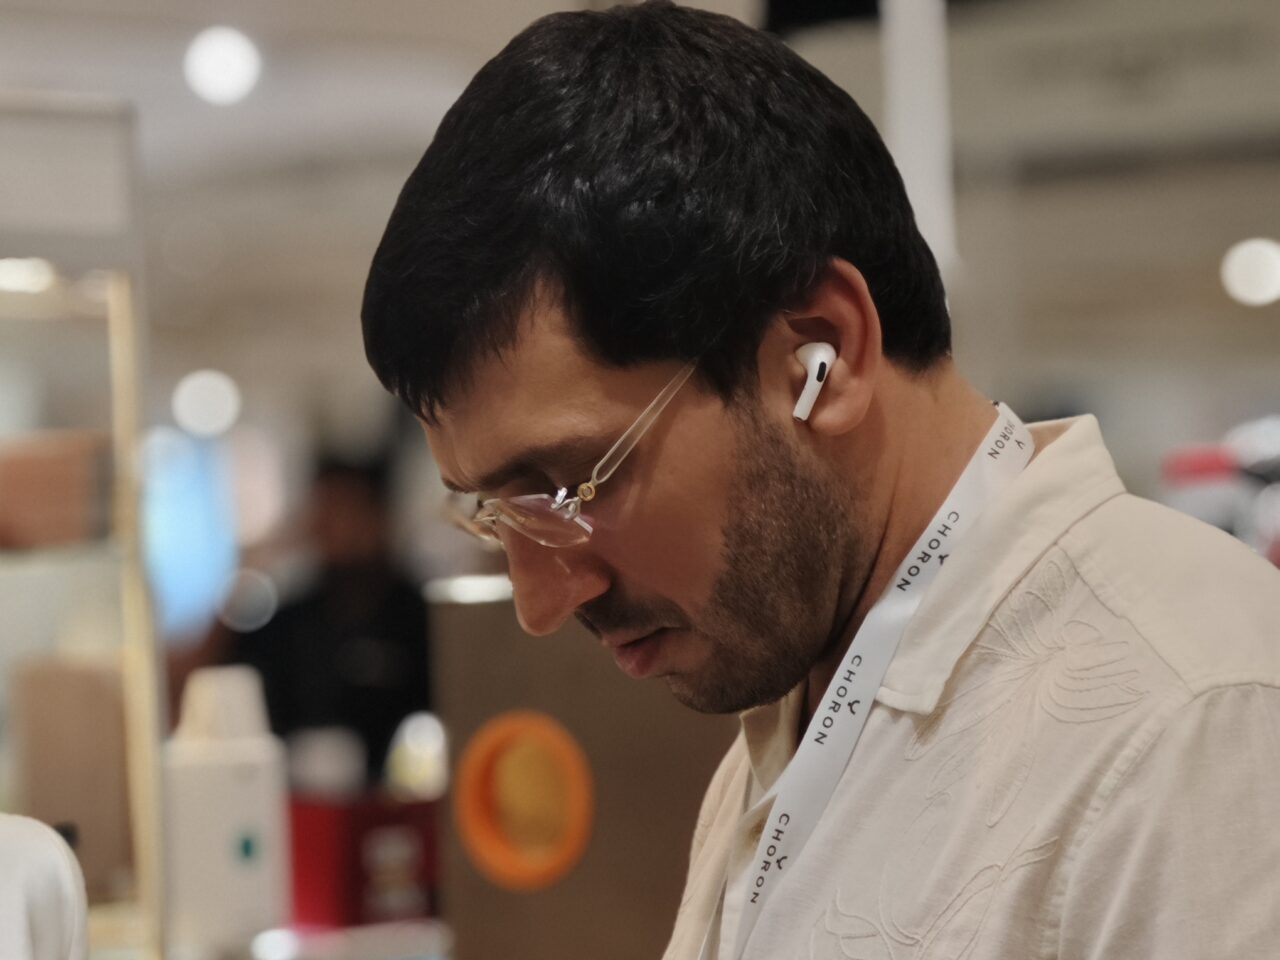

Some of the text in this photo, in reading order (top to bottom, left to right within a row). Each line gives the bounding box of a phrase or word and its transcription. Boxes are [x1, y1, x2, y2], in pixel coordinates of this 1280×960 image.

[987, 420, 1016, 459] HORON
[896, 511, 960, 592] CHORON
[814, 655, 862, 745] CHORON
[750, 813, 790, 904] CHORON
